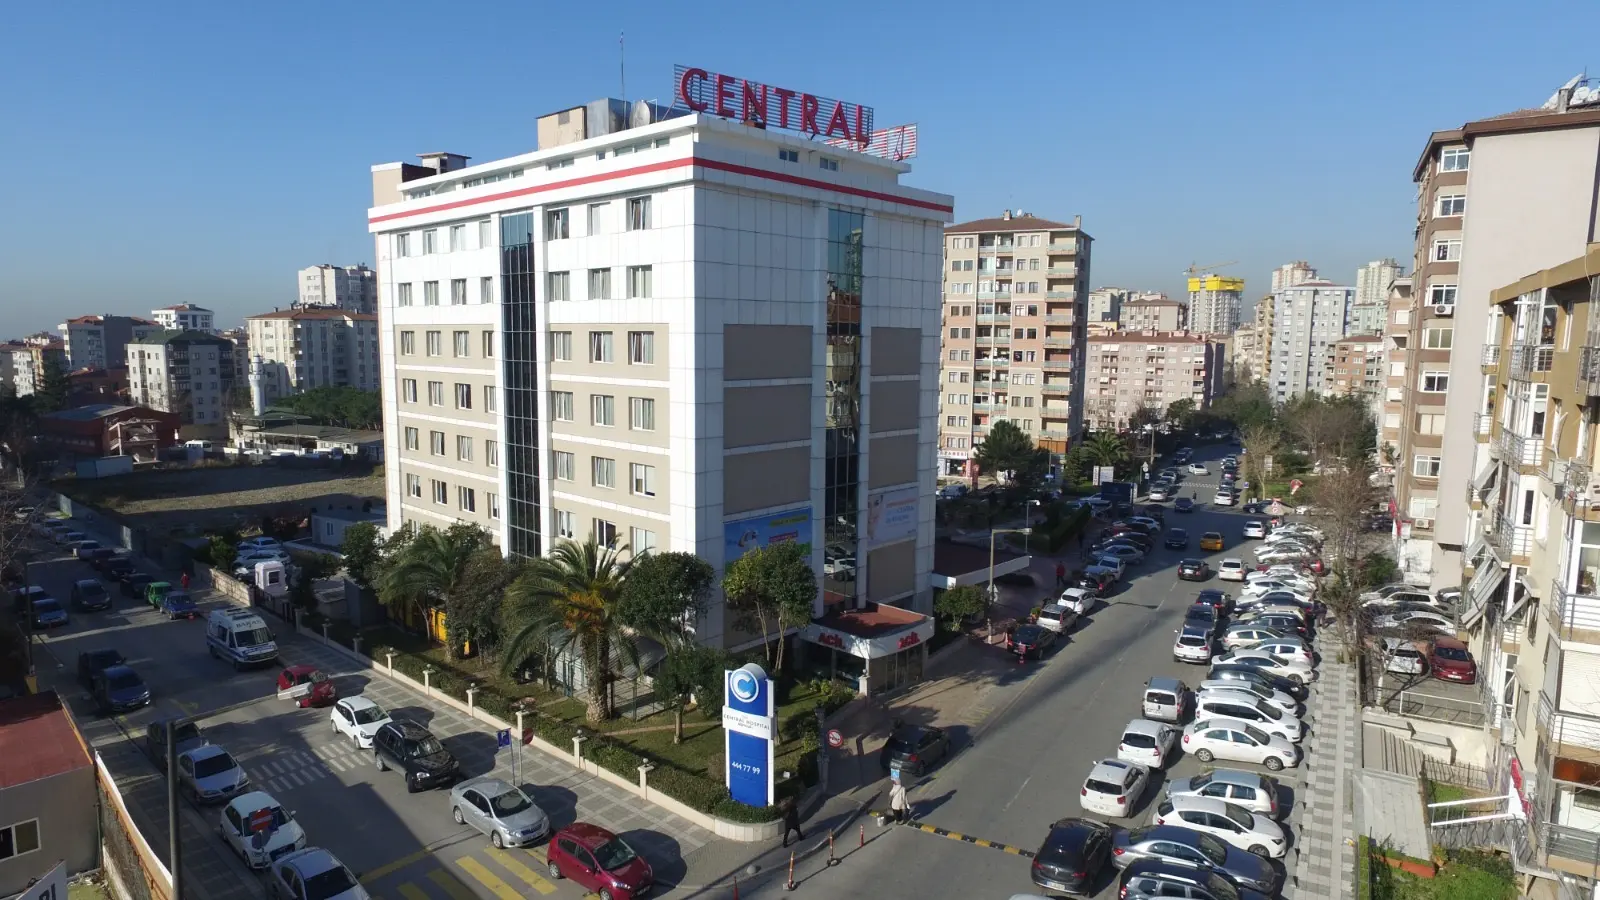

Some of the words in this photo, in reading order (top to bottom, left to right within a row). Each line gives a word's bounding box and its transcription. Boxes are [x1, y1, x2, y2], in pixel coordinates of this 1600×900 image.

[680, 67, 869, 144] CENTRAL
[724, 713, 745, 723] CENTRAL
[731, 761, 742, 771] 444
[743, 764, 751, 773] 77
[752, 766, 761, 776] 99
